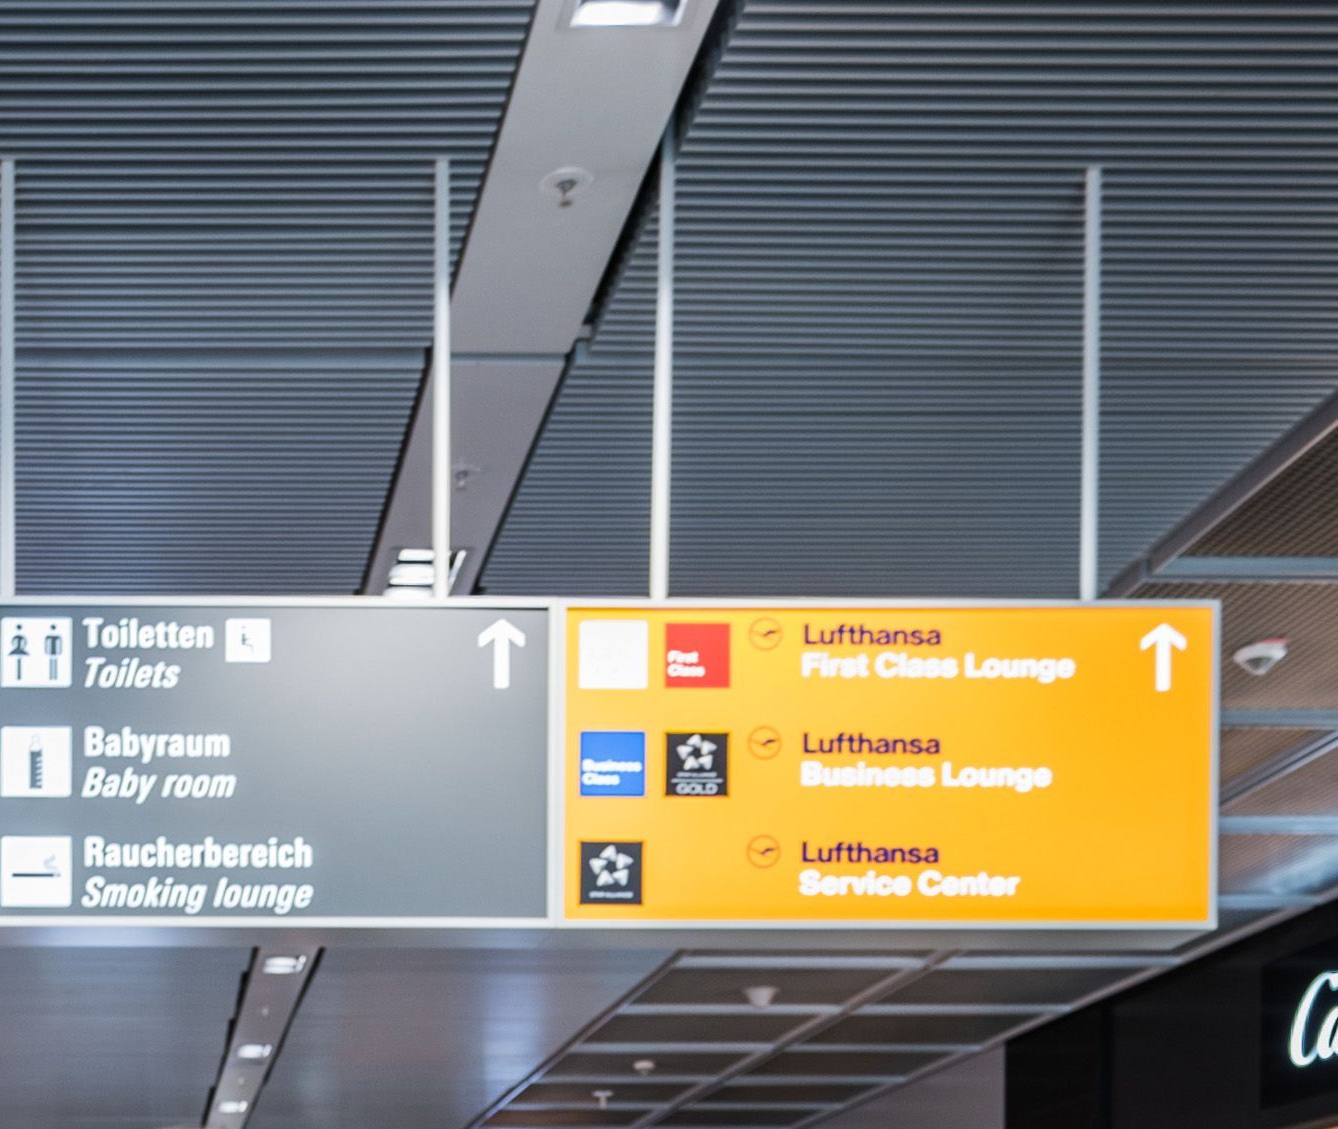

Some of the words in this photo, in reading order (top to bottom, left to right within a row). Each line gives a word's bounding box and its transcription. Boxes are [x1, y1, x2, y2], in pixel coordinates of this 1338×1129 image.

[82, 617, 215, 649] Toiletten
[803, 623, 941, 646] Lufthansa
[84, 657, 181, 689] Toilets
[800, 650, 870, 679] First
[873, 650, 960, 679] Class
[963, 651, 1076, 684] Lounge
[83, 726, 231, 764] Babyraum
[802, 732, 941, 755] Lufthansa
[81, 767, 157, 804] Baby
[161, 774, 237, 798] room
[800, 759, 936, 788] Business
[941, 760, 1053, 793] Lounge
[83, 836, 313, 868] Raucherbereich
[801, 841, 941, 865] Lufthansa
[81, 876, 207, 915] Smoking
[212, 876, 314, 915] lounge
[798, 868, 913, 897] Service
[916, 868, 1021, 897] Center
